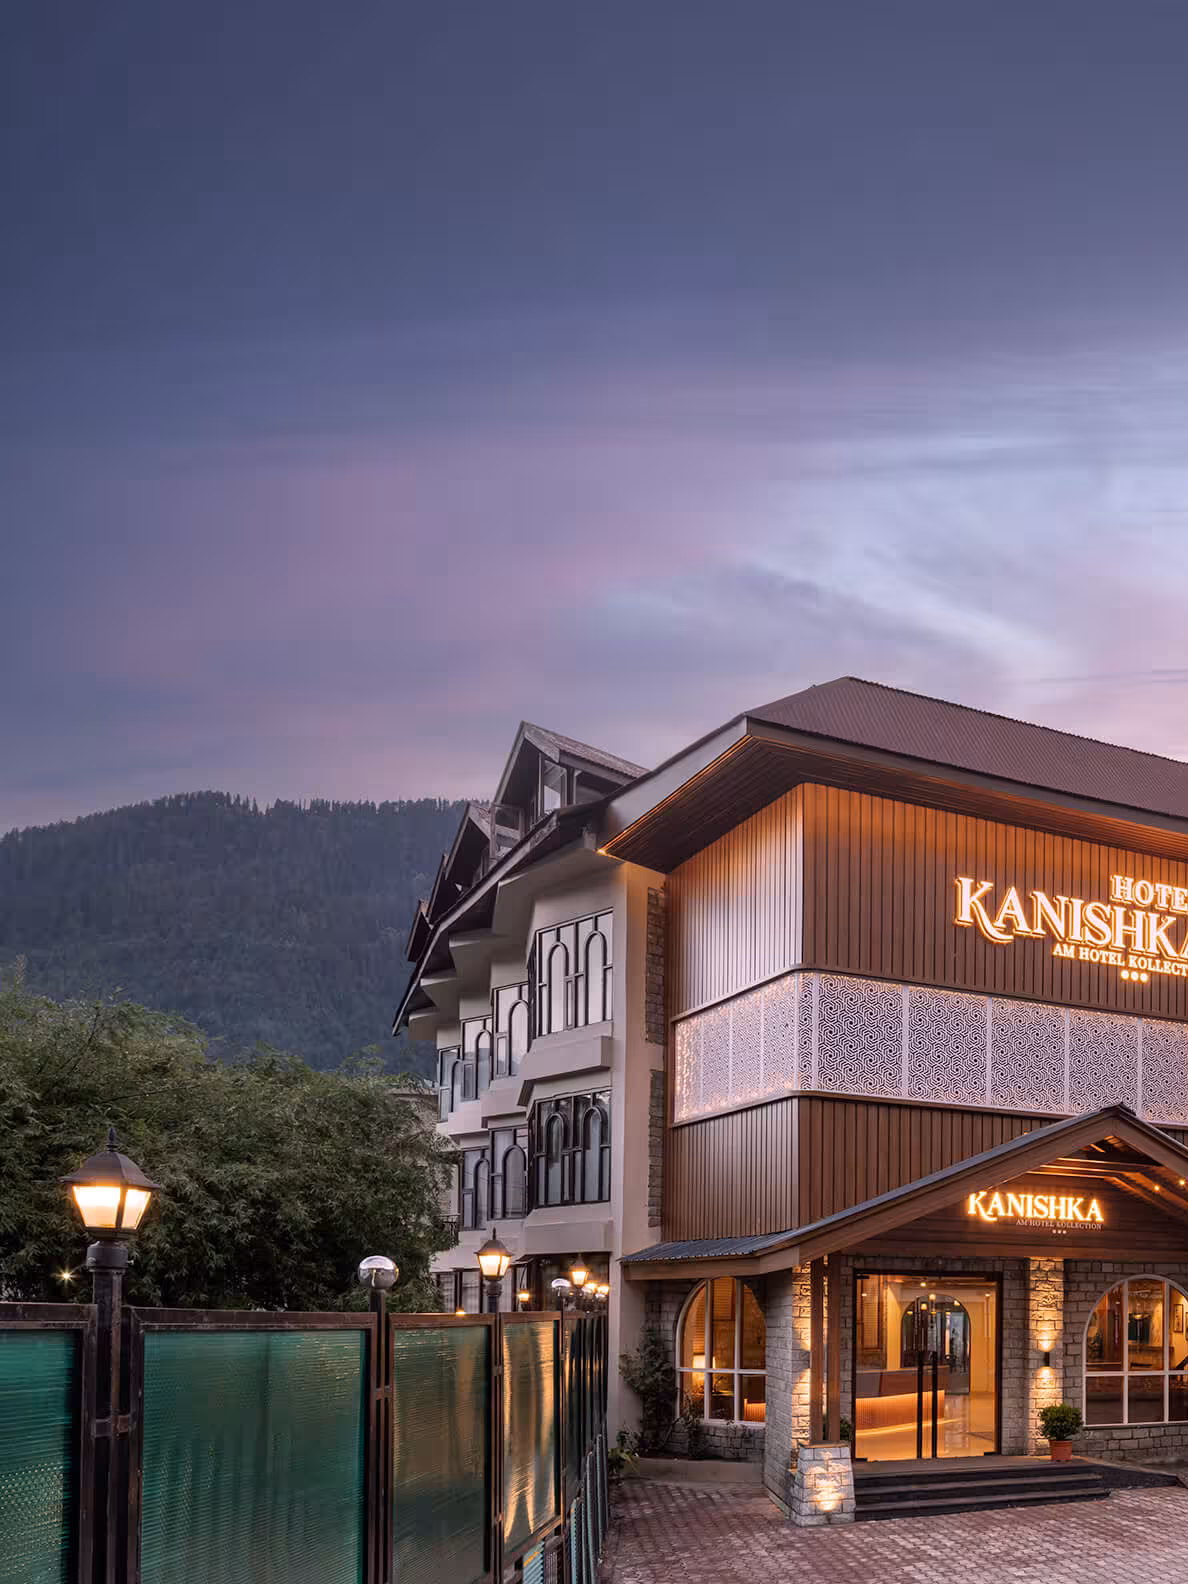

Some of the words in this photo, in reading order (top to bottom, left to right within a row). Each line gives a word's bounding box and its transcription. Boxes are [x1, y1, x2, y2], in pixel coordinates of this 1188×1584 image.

[1052, 943, 1075, 958] AM
[1079, 947, 1125, 966] HOTEL
[967, 1190, 1105, 1222] KANISHKA
[1056, 1221, 1102, 1230] KOLLECTION
